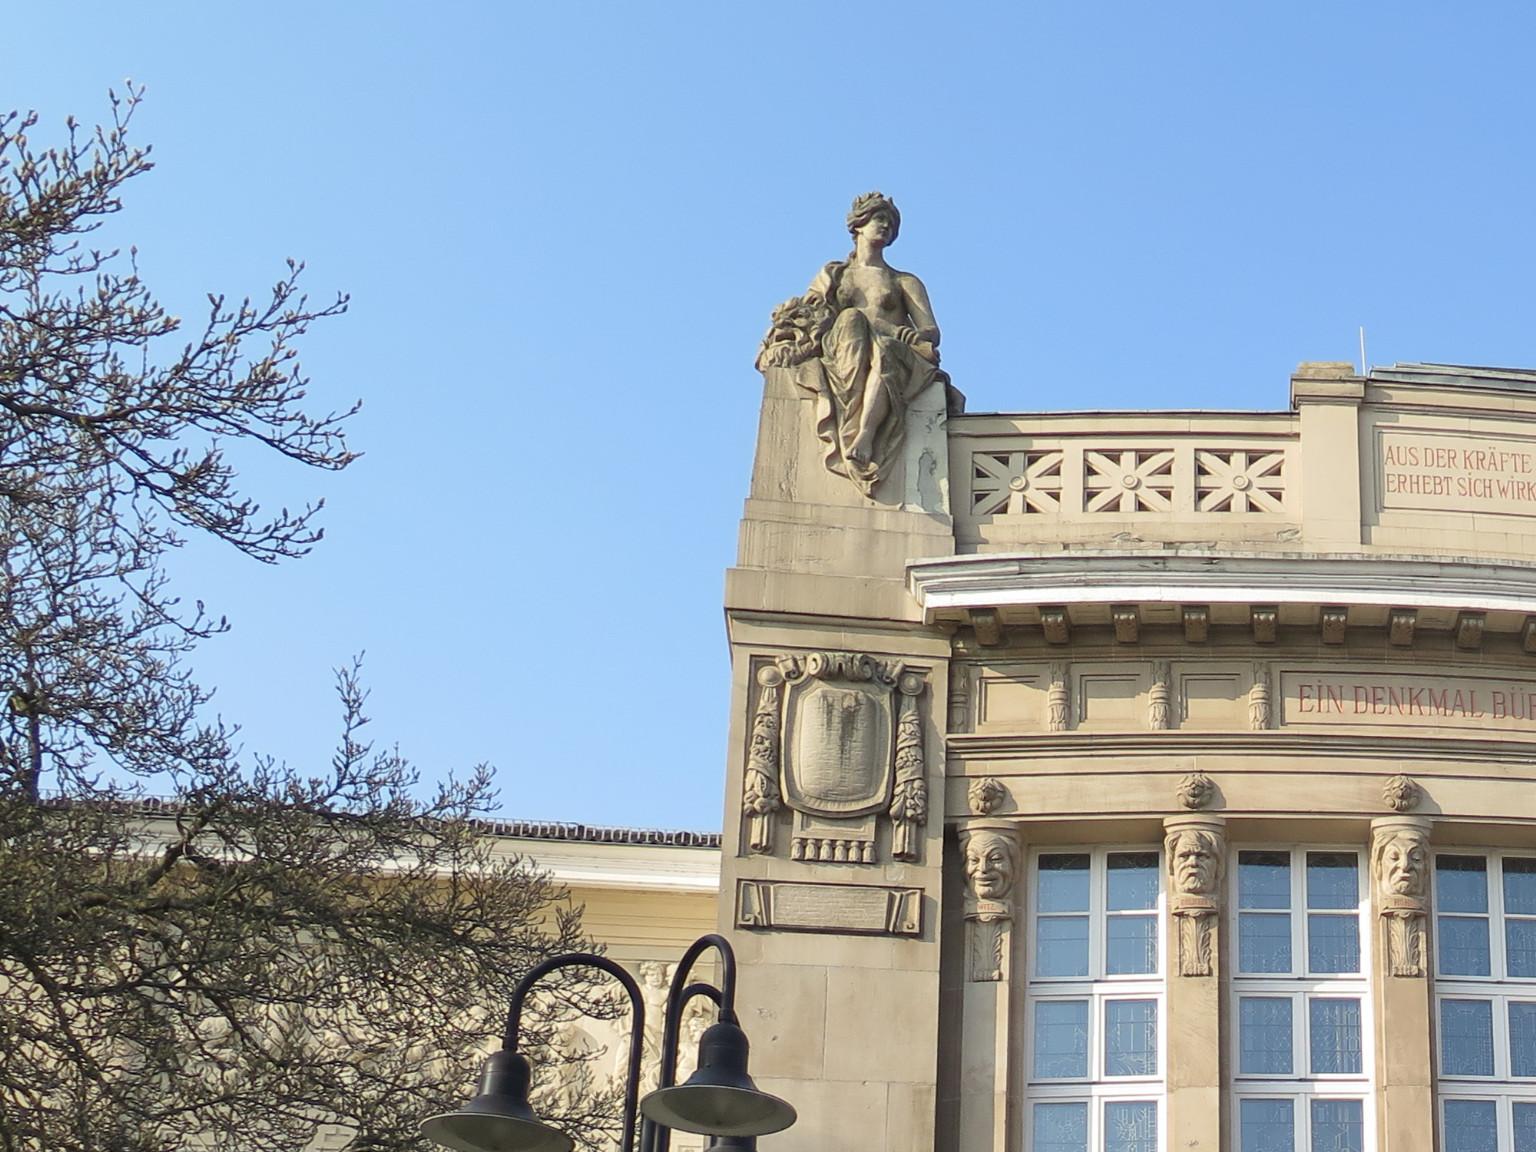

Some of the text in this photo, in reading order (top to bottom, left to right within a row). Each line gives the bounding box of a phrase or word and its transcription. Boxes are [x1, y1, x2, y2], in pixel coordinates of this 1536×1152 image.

[1384, 446, 1420, 467] AUS
[1424, 447, 1458, 470] DER
[1463, 446, 1533, 474] KRÄFTE
[1386, 473, 1453, 497] ERHEBT
[1457, 471, 1494, 499] SICH
[1298, 679, 1344, 713] EIN
[1353, 684, 1487, 719] DENKMAL
